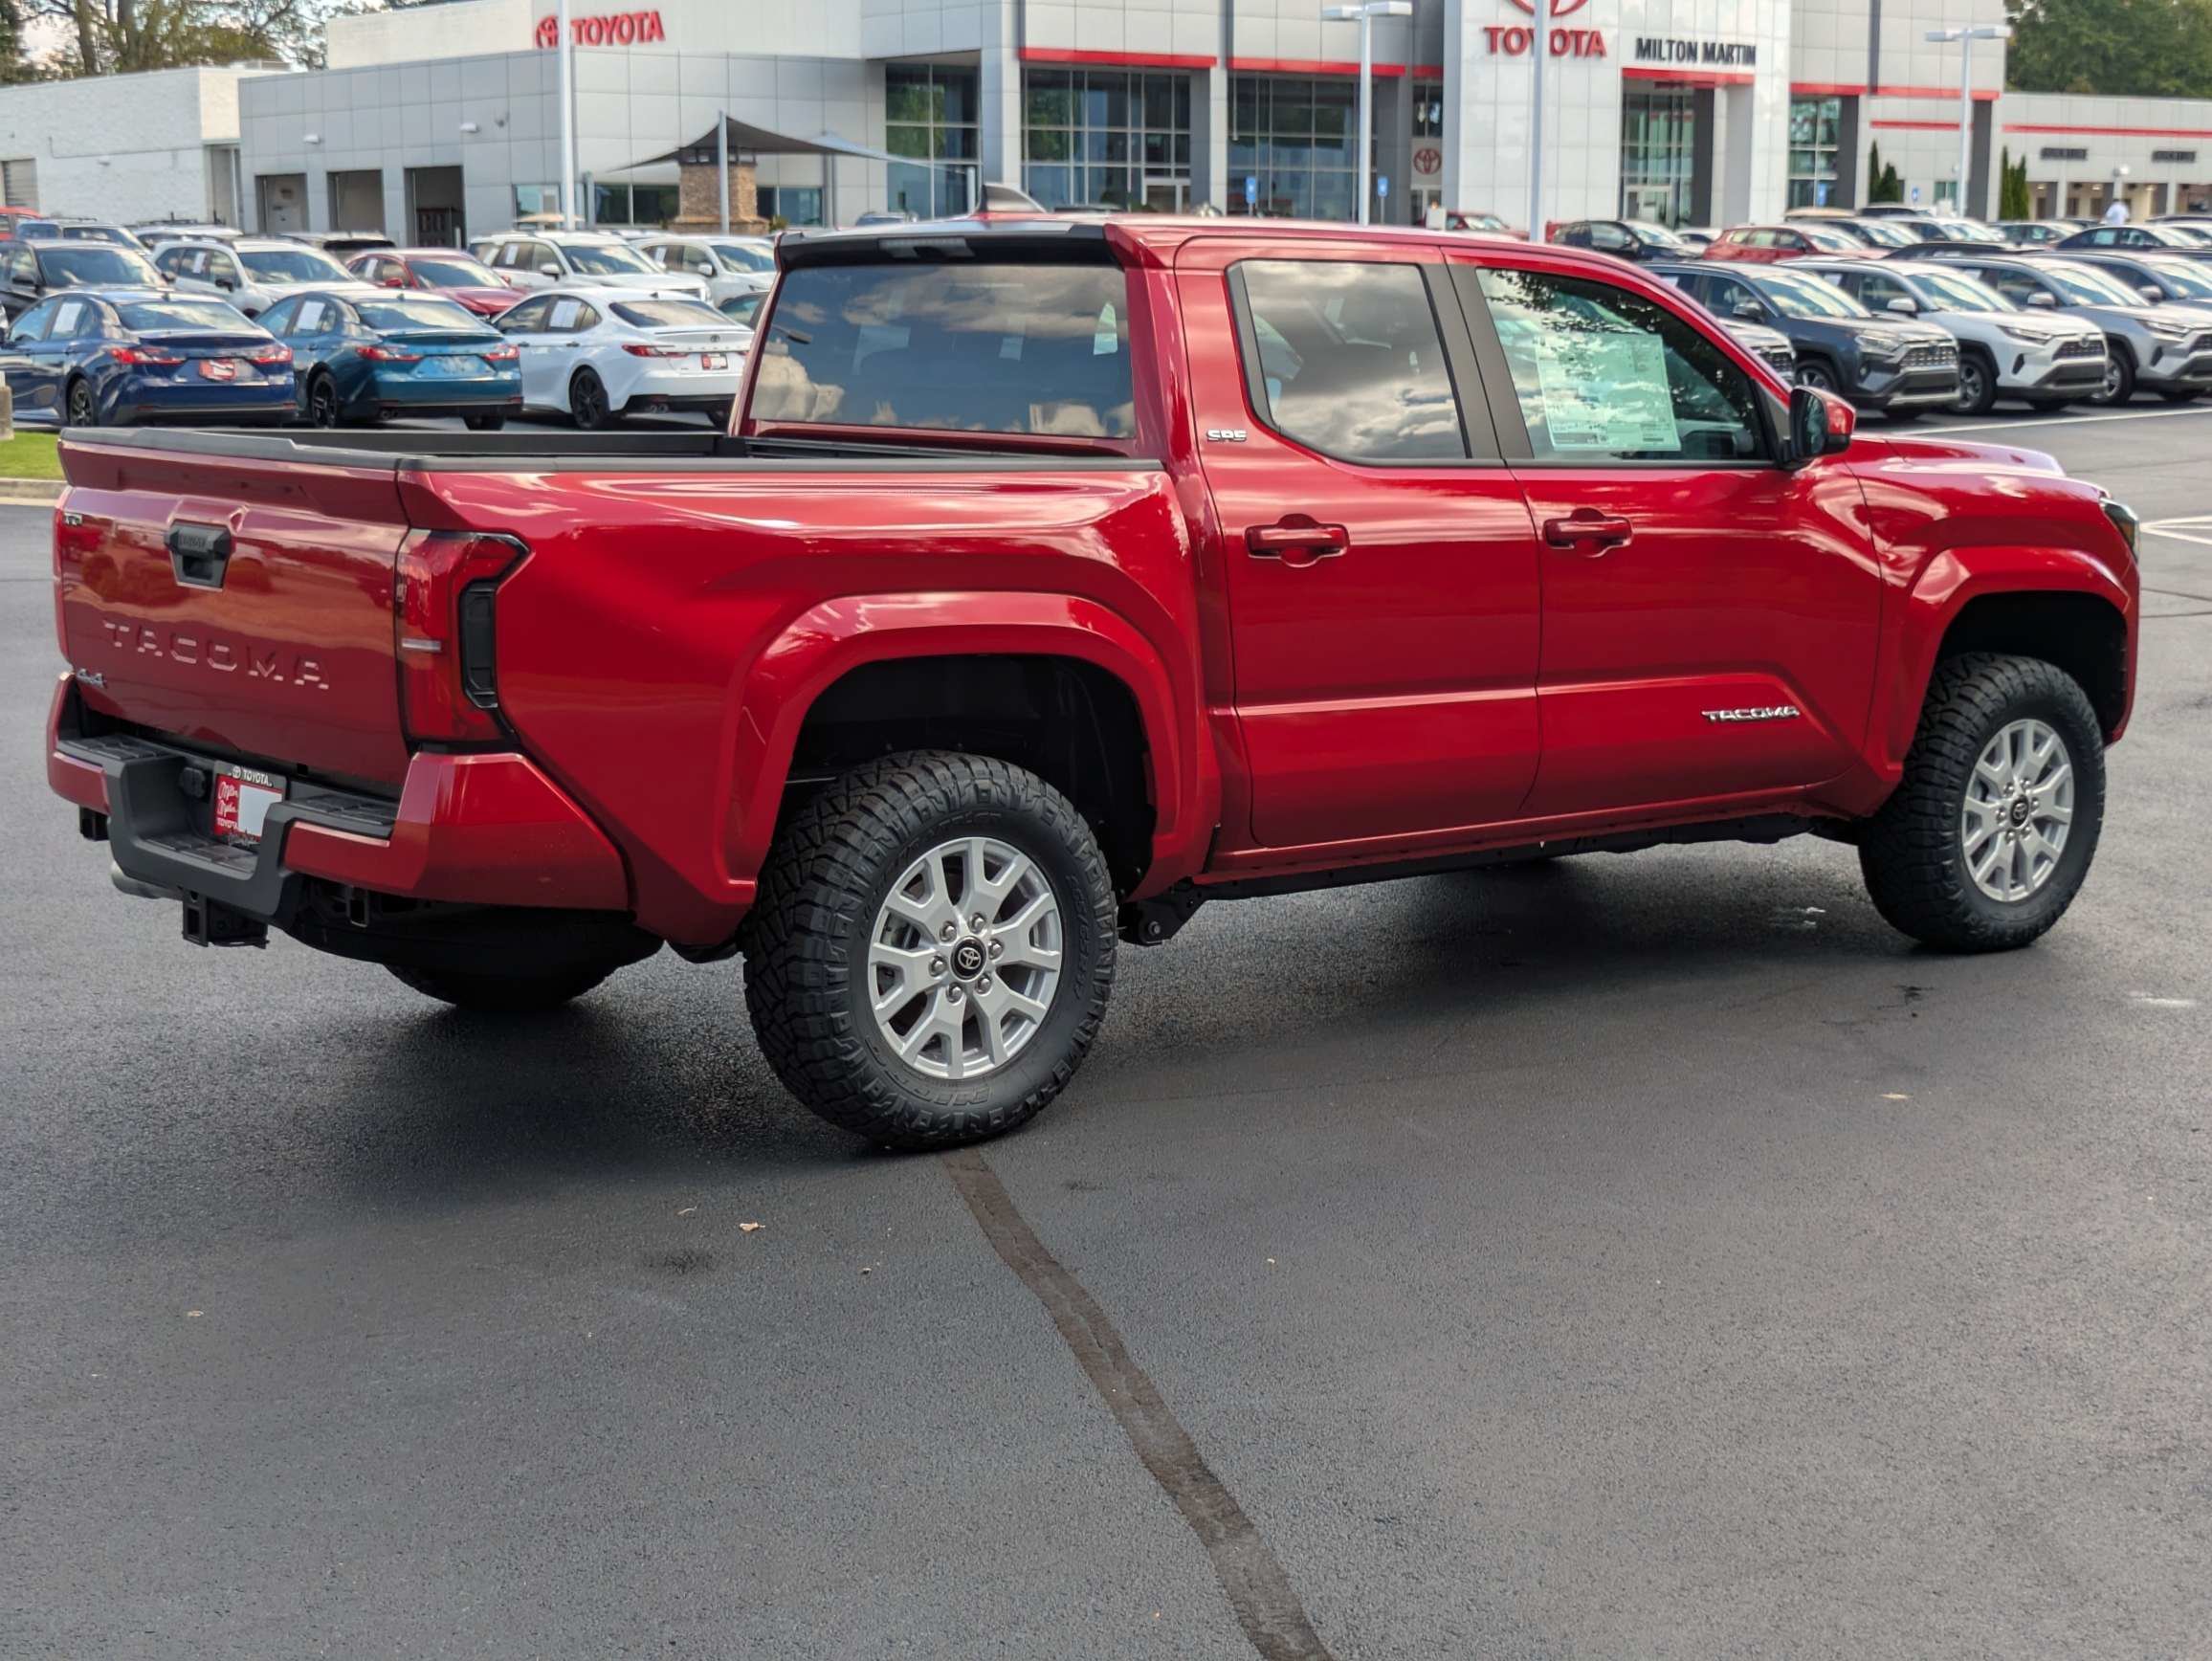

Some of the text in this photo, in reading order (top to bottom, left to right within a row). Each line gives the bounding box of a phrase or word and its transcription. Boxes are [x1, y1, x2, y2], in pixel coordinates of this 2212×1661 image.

[570, 11, 666, 47] TOYOTA
[1635, 36, 1757, 65] MILTON MARTIN
[102, 620, 329, 689] TACOMA
[1702, 705, 1800, 721] TACOMA
[243, 768, 270, 786] TOYOTA
